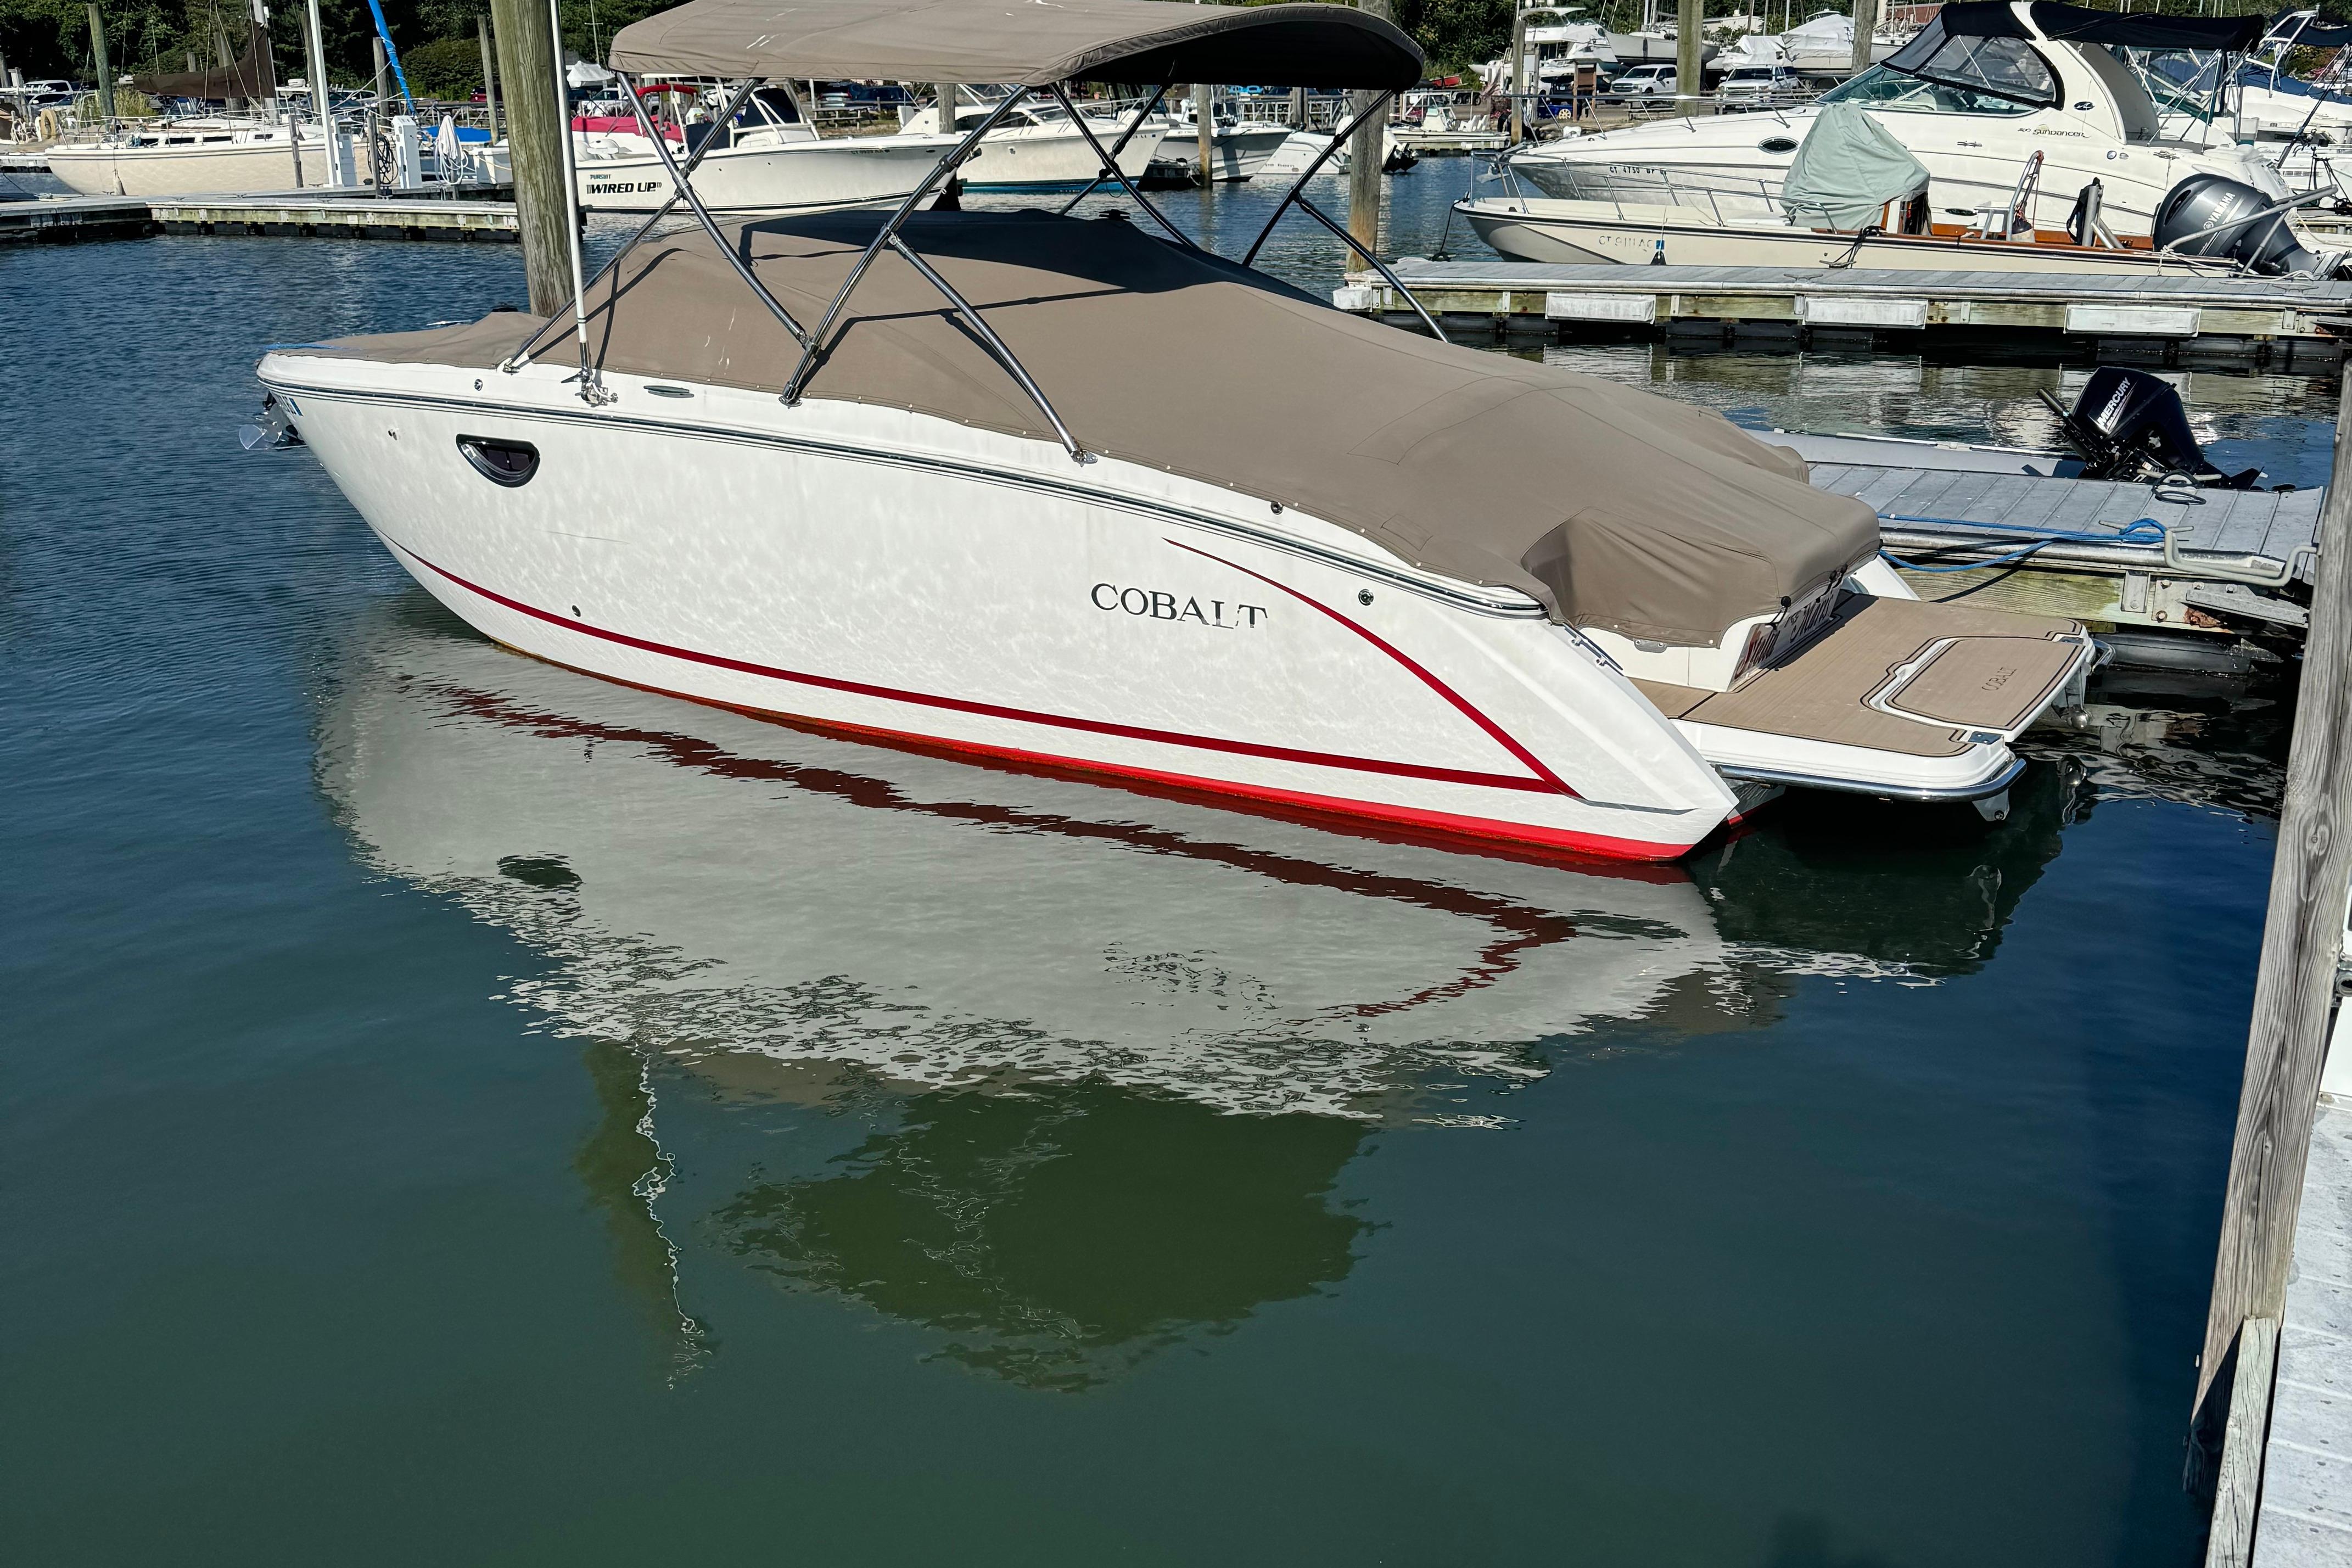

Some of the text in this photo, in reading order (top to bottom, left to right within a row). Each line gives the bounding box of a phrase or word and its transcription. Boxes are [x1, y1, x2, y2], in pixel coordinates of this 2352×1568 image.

[591, 183, 634, 194] WIRED
[2208, 192, 2236, 222] YAMAHA
[1599, 236, 1611, 245] CT
[2097, 377, 2130, 427] MERCURY
[1091, 583, 1268, 629] COBALT
[1981, 667, 2017, 691] COBALT
